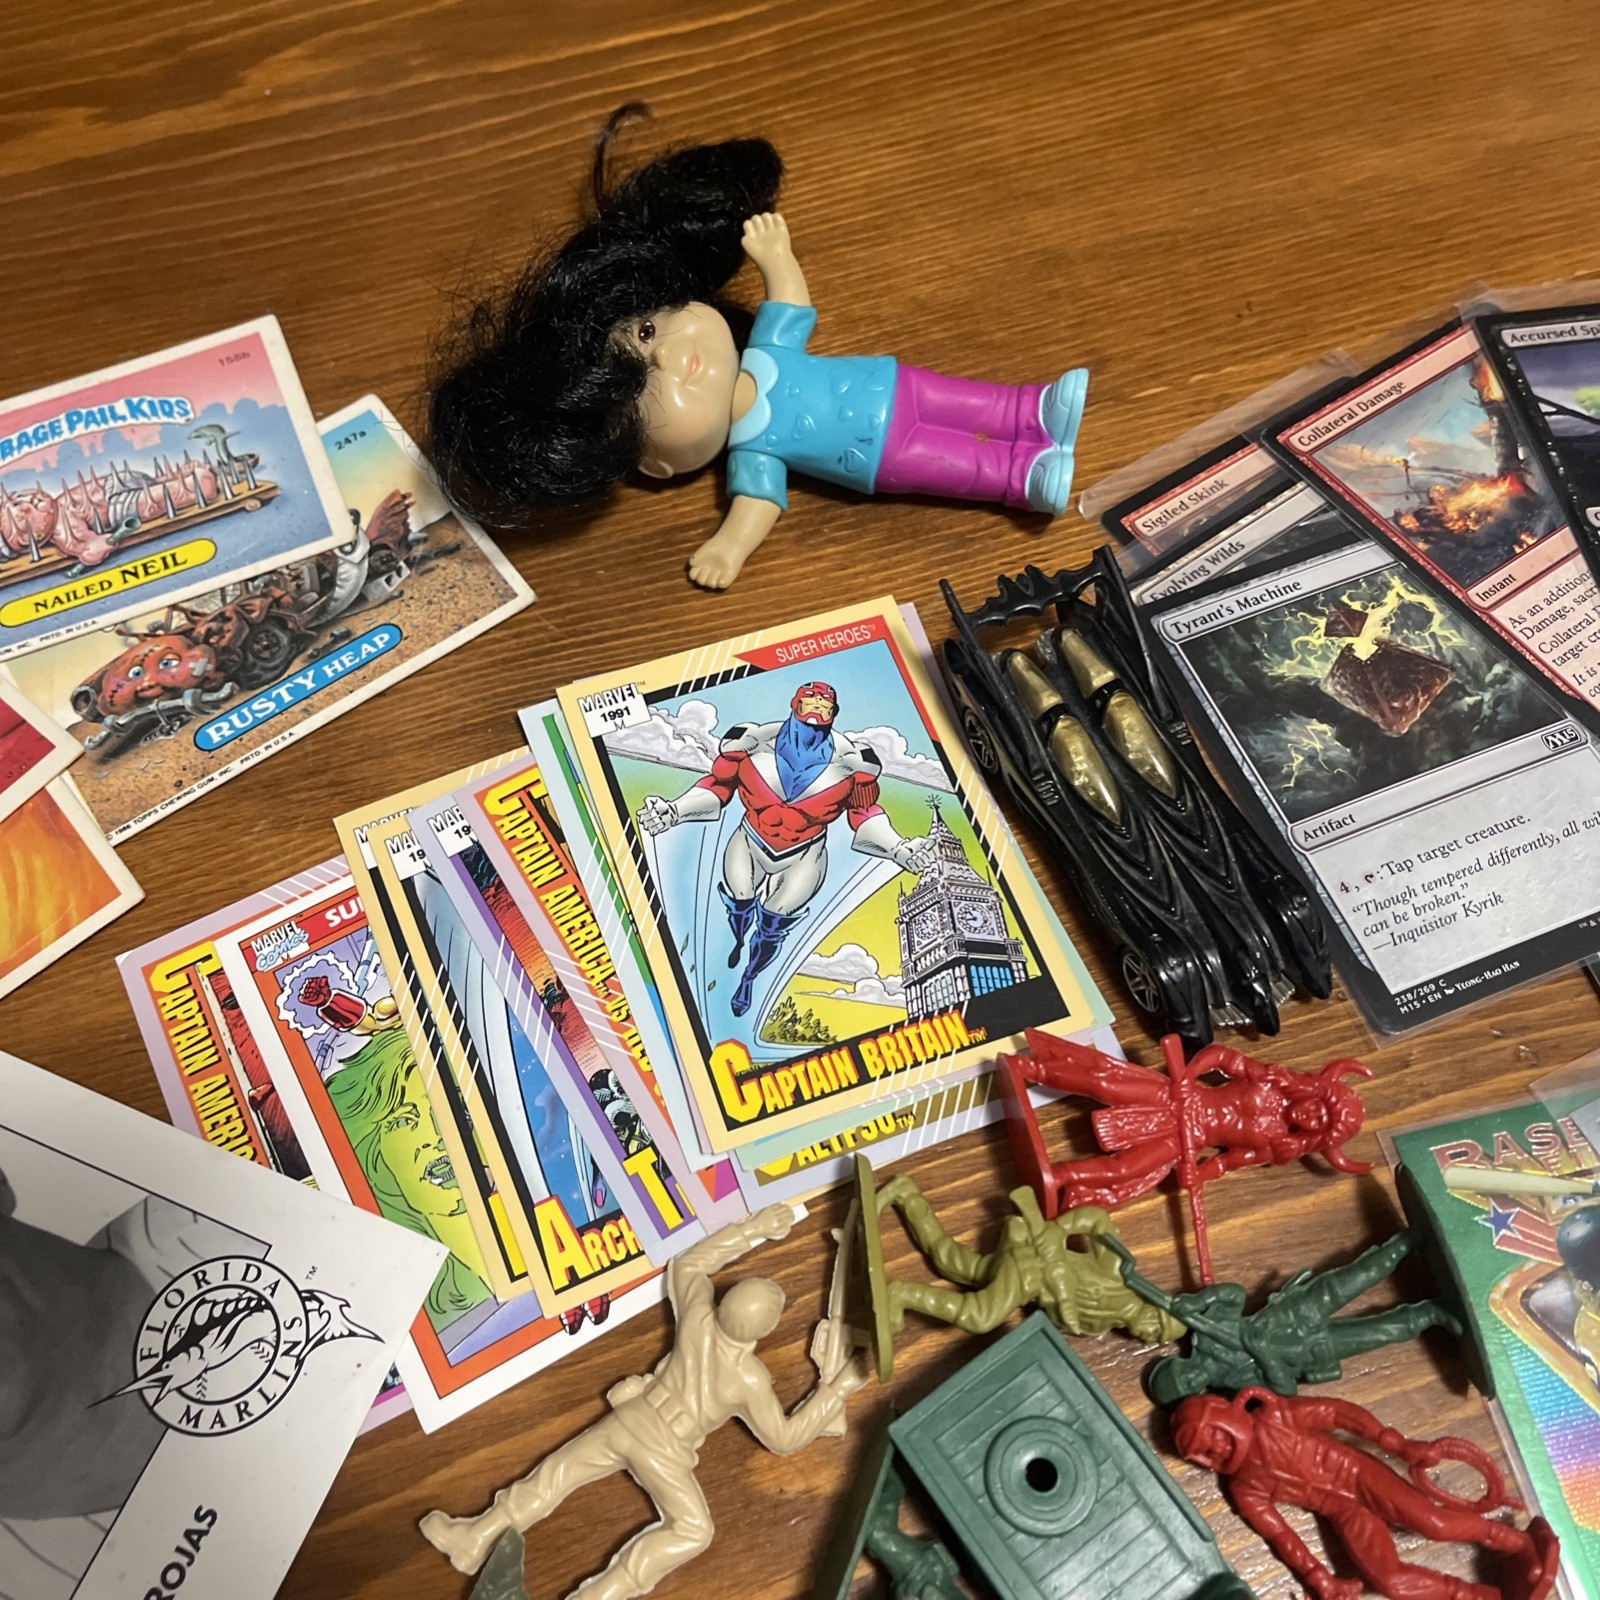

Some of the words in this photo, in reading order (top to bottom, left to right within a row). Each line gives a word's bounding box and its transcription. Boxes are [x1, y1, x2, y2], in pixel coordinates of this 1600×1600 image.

[1510, 325, 1577, 343] Accursed
[65, 403, 127, 433] PAIL
[123, 395, 192, 422] KIDS
[1298, 407, 1358, 446] Collateral
[1356, 381, 1406, 412] Damage
[1142, 500, 1189, 532] Sigiled
[1187, 480, 1229, 505] Skink
[34, 579, 113, 613] NAILED
[121, 552, 188, 585] NEIL
[1149, 565, 1211, 601] Evolving
[1205, 541, 1245, 567] Wilds
[1475, 573, 1517, 602] Instant
[1170, 603, 1235, 636] Tyrant's
[1234, 578, 1302, 612] Machine
[1508, 614, 1527, 629] As
[1526, 603, 1544, 617] an
[1519, 606, 1575, 640] Damage,
[776, 641, 818, 663] SUPER
[819, 626, 871, 652] HEROES
[1538, 613, 1596, 655] Collateral
[1552, 641, 1588, 667] target
[205, 668, 316, 744] RUSTY
[322, 633, 390, 678] HEAP
[1572, 673, 1586, 686] It
[1584, 666, 1597, 678] is
[577, 683, 641, 713] MARVEL
[600, 706, 631, 722] 1991
[133, 808, 159, 825] TOPPS
[160, 787, 196, 810] CHEWING
[264, 743, 273, 752] IN
[483, 766, 568, 889] CAPTAIN
[1302, 814, 1356, 842] Artifact
[1417, 839, 1462, 864] target
[1464, 813, 1531, 845] creature.
[1421, 858, 1484, 893] tempered
[1487, 831, 1560, 870] differently,
[1562, 819, 1580, 838] all
[1363, 920, 1390, 937] can
[1392, 910, 1410, 926] be
[1461, 891, 1504, 919] Kyrik
[250, 921, 301, 953] MARVEL
[256, 929, 310, 972] COMICS
[150, 940, 223, 1076] CAPTAIN
[1394, 983, 1436, 1006] 238/269
[1438, 979, 1447, 988] C
[1399, 1001, 1421, 1015] M15
[1427, 992, 1443, 1004] EN
[709, 1038, 860, 1123] CAPTAIN
[858, 1009, 970, 1078] BRITAIN
[140, 1261, 282, 1363] FLORIDA
[178, 1316, 304, 1430] MARLINS
